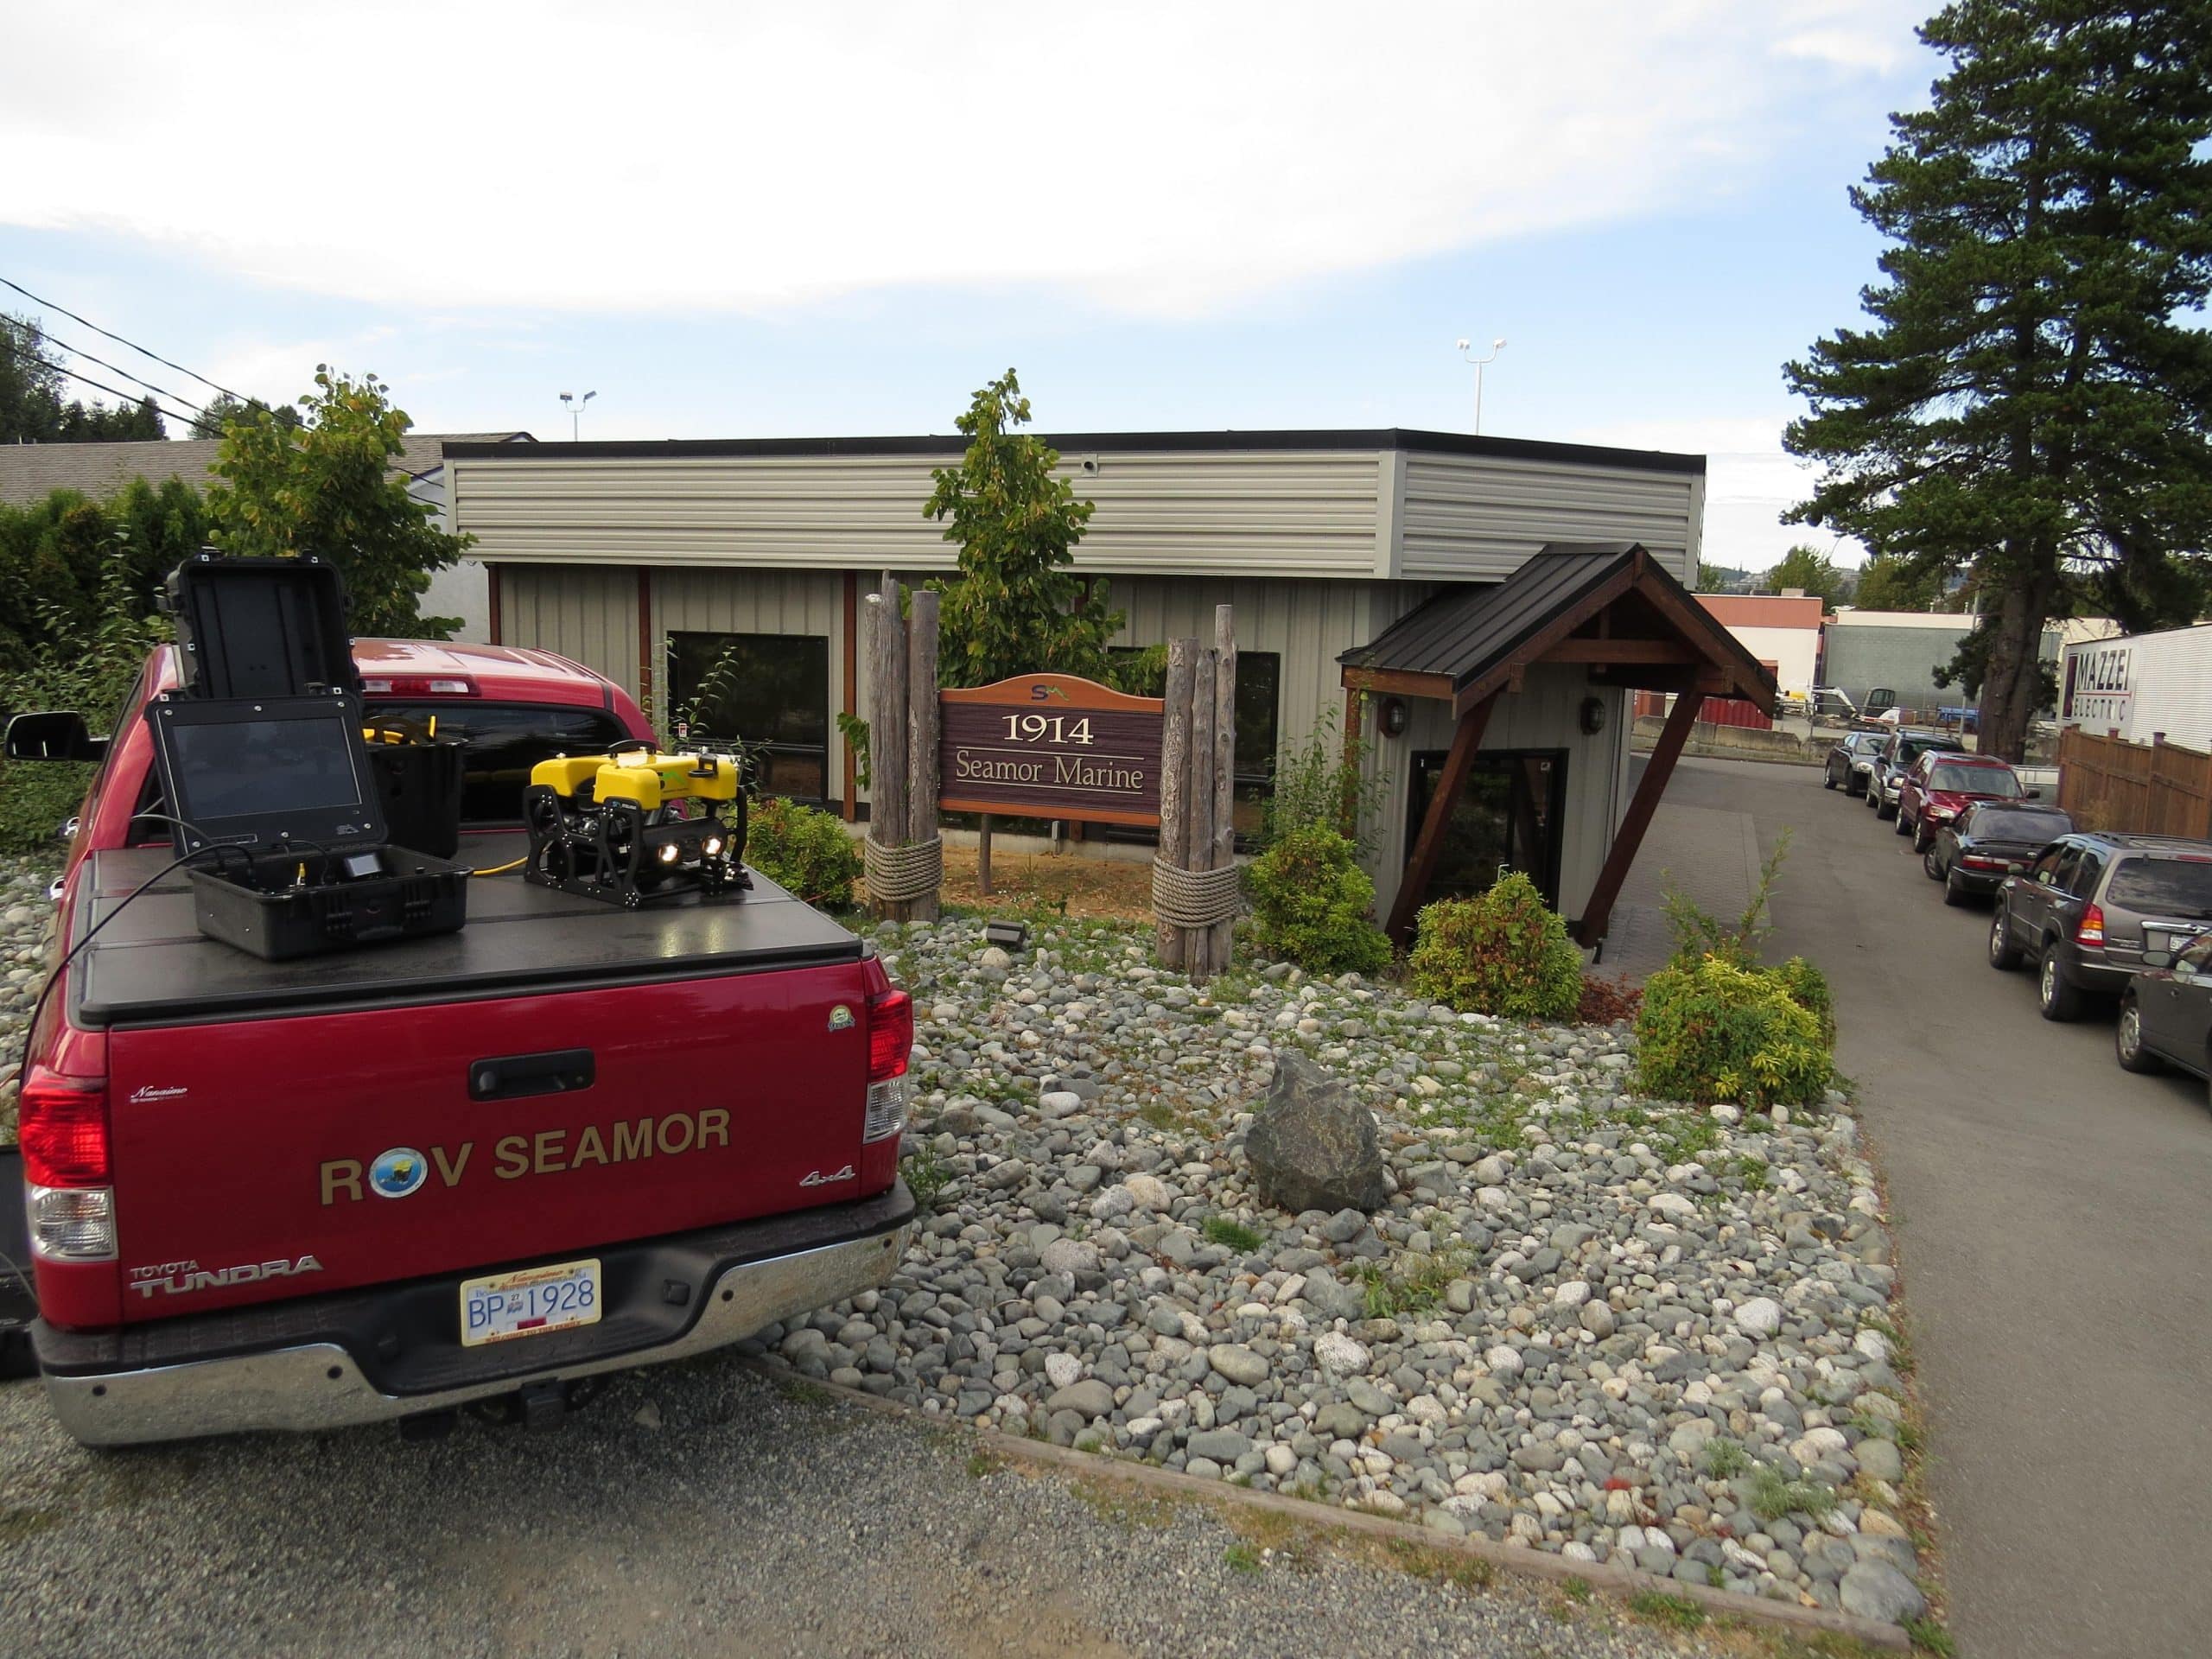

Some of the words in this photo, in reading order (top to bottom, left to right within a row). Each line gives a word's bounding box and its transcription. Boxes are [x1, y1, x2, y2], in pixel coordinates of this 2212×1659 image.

[2076, 648, 2133, 690] MAZZEI
[2074, 697, 2126, 721] ELECTRC
[1002, 714, 1094, 745] 1914
[956, 749, 1043, 781] Seamor
[1053, 756, 1144, 789] Marine
[320, 1142, 474, 1205] ROV
[493, 1108, 731, 1179] SEAMOR
[799, 1165, 855, 1187] 4x4
[130, 1260, 200, 1279] TOYOTA
[130, 1255, 324, 1299] TUNDRA
[469, 1295, 505, 1329] BP
[528, 1279, 594, 1317] 1928
